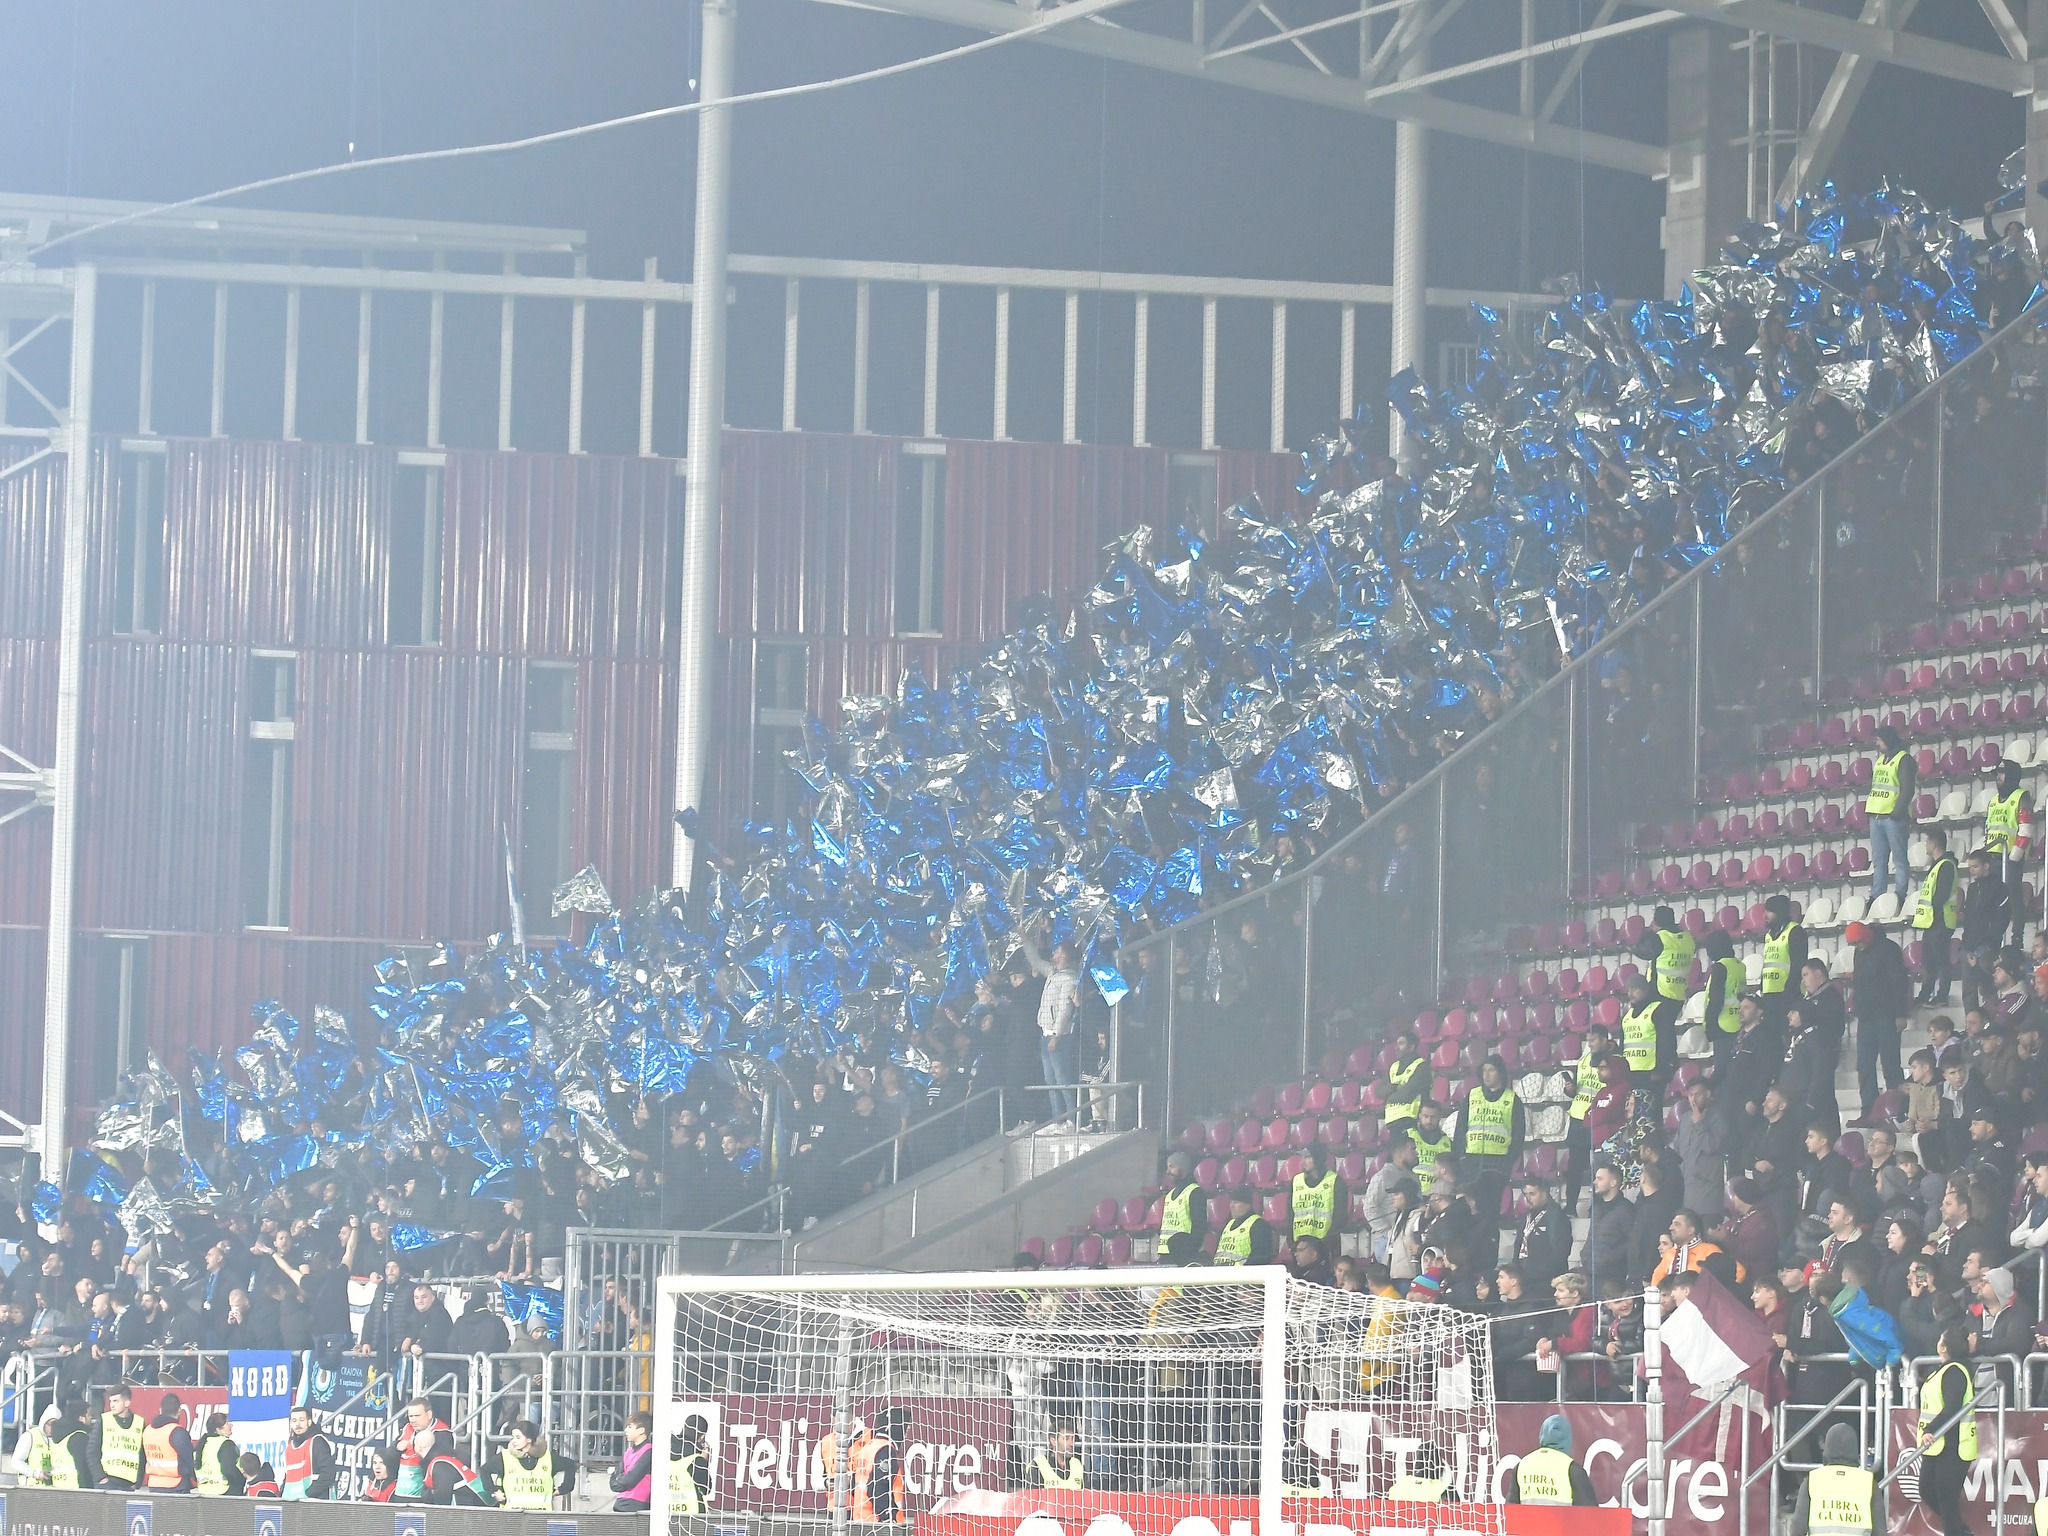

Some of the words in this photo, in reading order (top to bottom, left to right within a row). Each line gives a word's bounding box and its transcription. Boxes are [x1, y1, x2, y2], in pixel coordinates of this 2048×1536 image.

[1476, 1107, 1503, 1117] LIBRA
[1473, 1115, 1504, 1125] GUARD
[1469, 1132, 1506, 1144] STEWARD
[1299, 1193, 1323, 1201] LIBRA
[1295, 1200, 1325, 1209] GUARD
[1293, 1218, 1325, 1230] STEWARD
[340, 1366, 363, 1378] CRAIOVA
[231, 1364, 289, 1398] NORD
[1523, 1475, 1555, 1486] LIBRA
[1521, 1486, 1558, 1496] GUARD
[1822, 1499, 1860, 1511] LIBRA
[1818, 1511, 1862, 1523] GUARD
